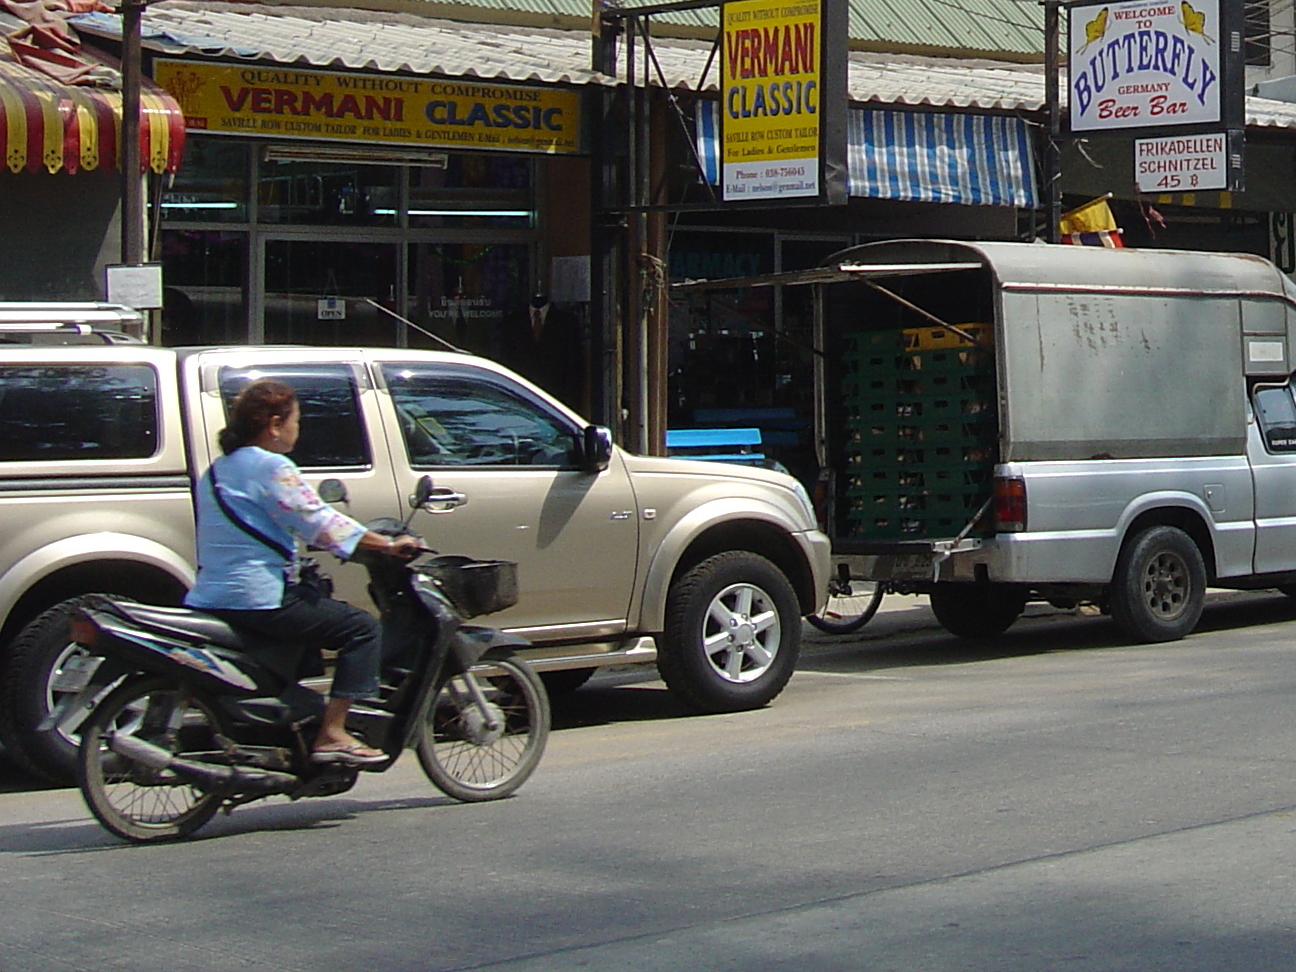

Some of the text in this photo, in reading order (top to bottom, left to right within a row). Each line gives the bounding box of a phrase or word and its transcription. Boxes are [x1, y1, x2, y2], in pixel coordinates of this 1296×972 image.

[1114, 6, 1176, 21] WELCOME
[1136, 20, 1152, 29] TO
[725, 22, 815, 81] VERMANI
[1074, 30, 1216, 117] BUTTERFLY
[240, 68, 542, 102] QUALITY WITHOUT COMPROMISE
[1117, 83, 1171, 95] GERMANY
[727, 80, 817, 119] CLASSIC
[1097, 95, 1189, 119] Beer Bar
[219, 85, 564, 132] VERMANI CLASSIC
[424, 130, 475, 142] GENTLEMEN
[727, 149, 739, 158] For
[1139, 138, 1223, 157] FRIKADELLEN
[1139, 157, 1217, 174] SCHNITZEL
[736, 171, 758, 180] Phone
[1157, 174, 1181, 188] 45
[320, 310, 342, 318] OPEN
